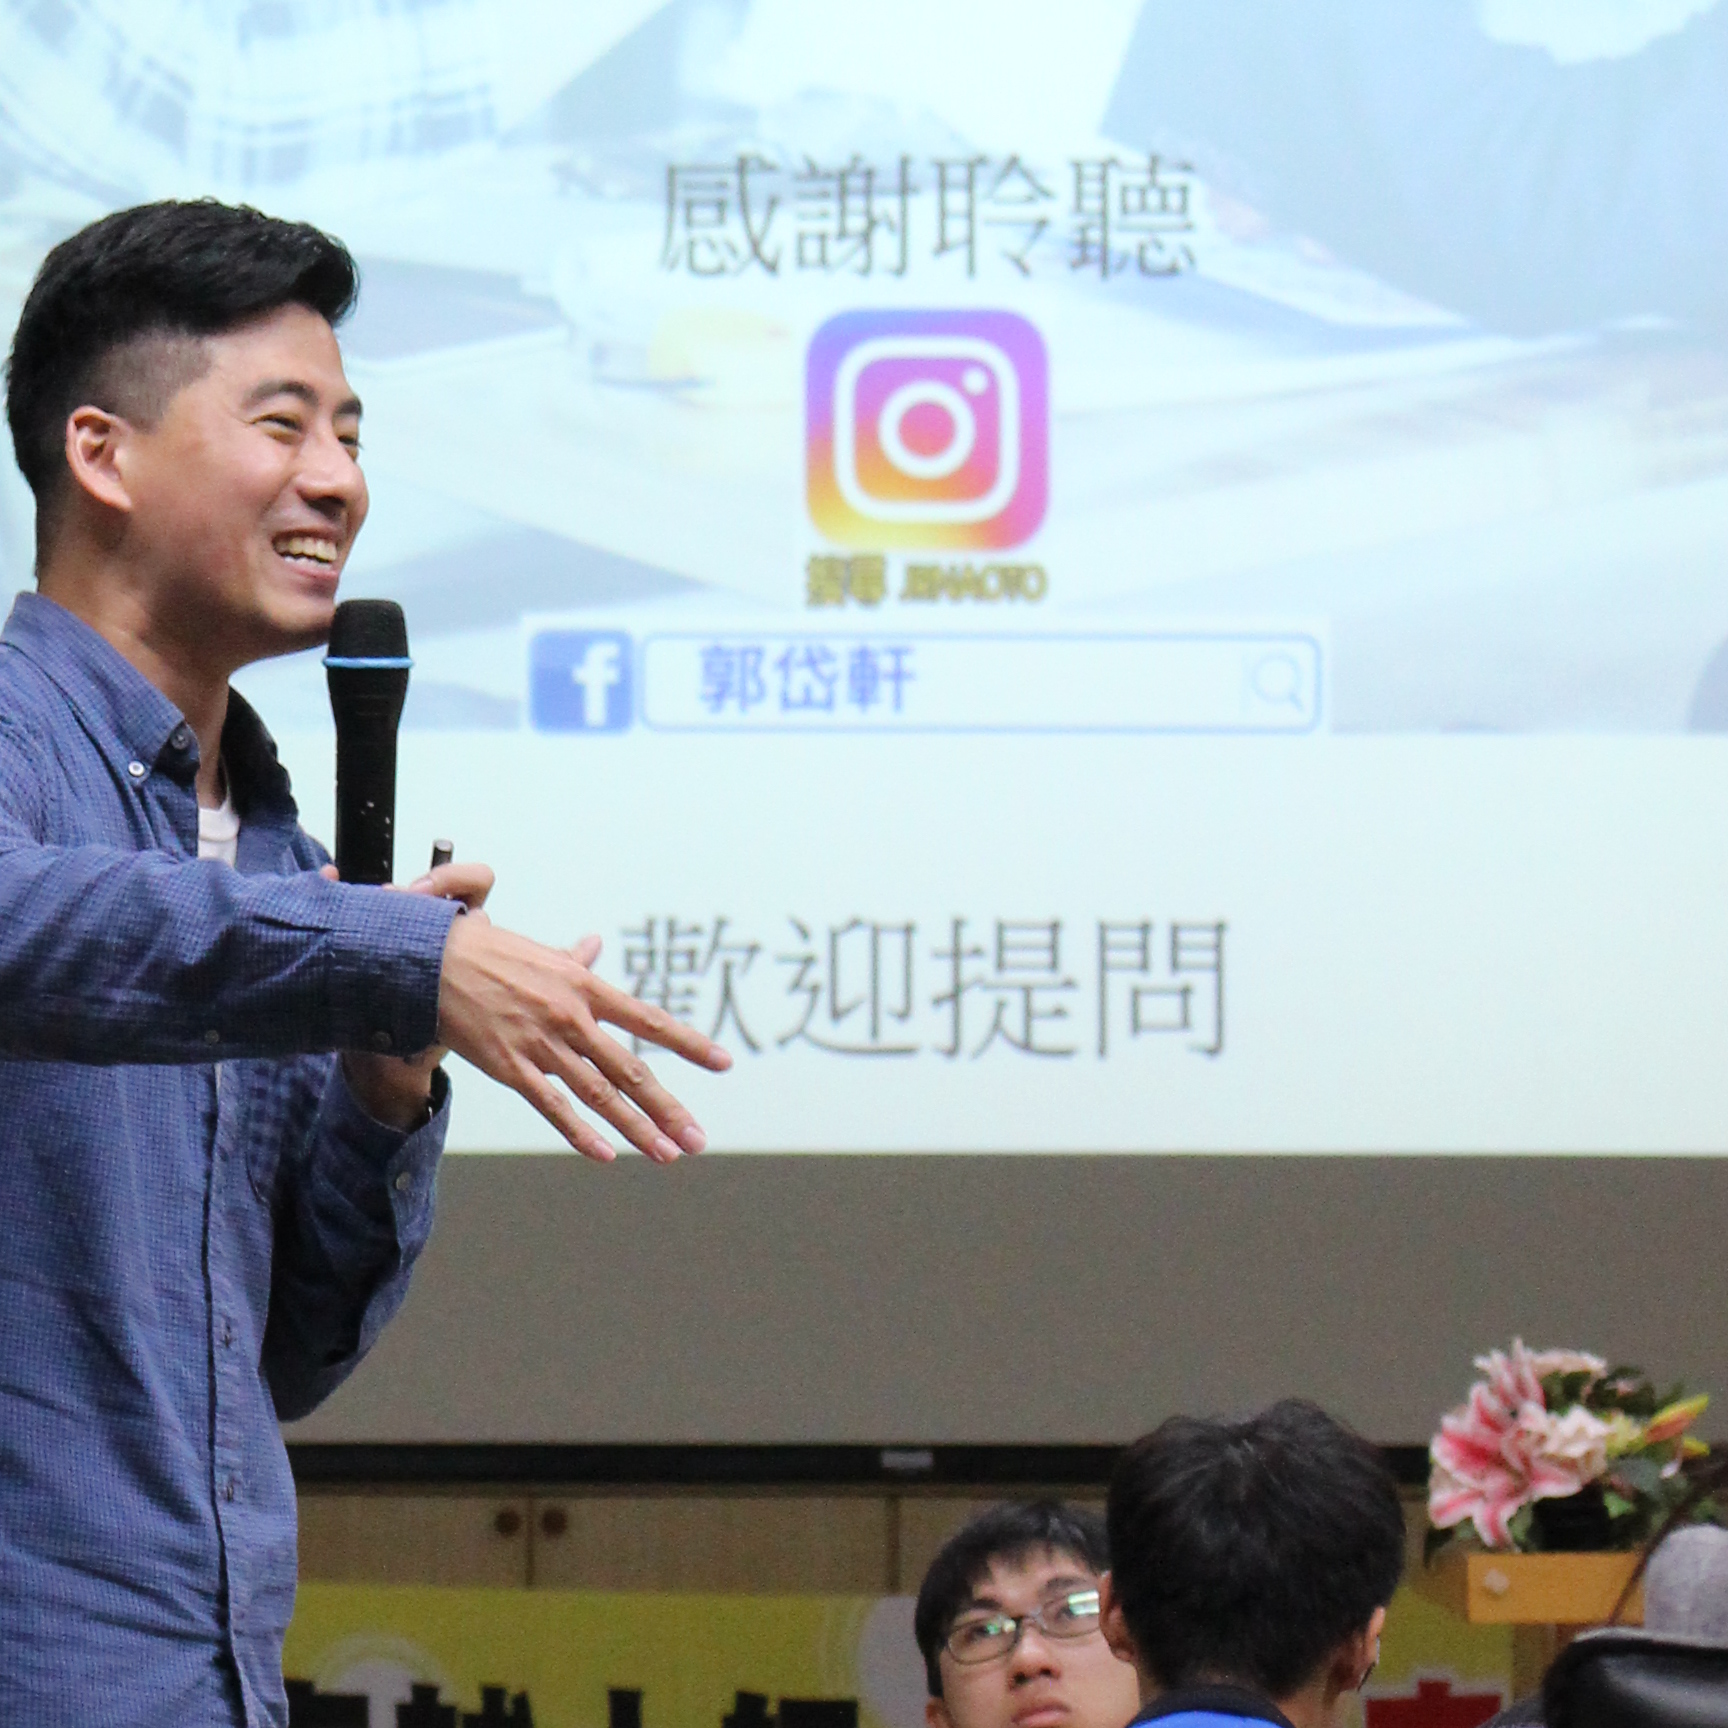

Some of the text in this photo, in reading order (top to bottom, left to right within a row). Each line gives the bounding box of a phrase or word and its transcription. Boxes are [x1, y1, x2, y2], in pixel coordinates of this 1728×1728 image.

[663, 154, 1197, 280] 感謝聆聽
[698, 642, 915, 713] 郭岱軒
[619, 914, 1229, 1060] 歡迎提問
